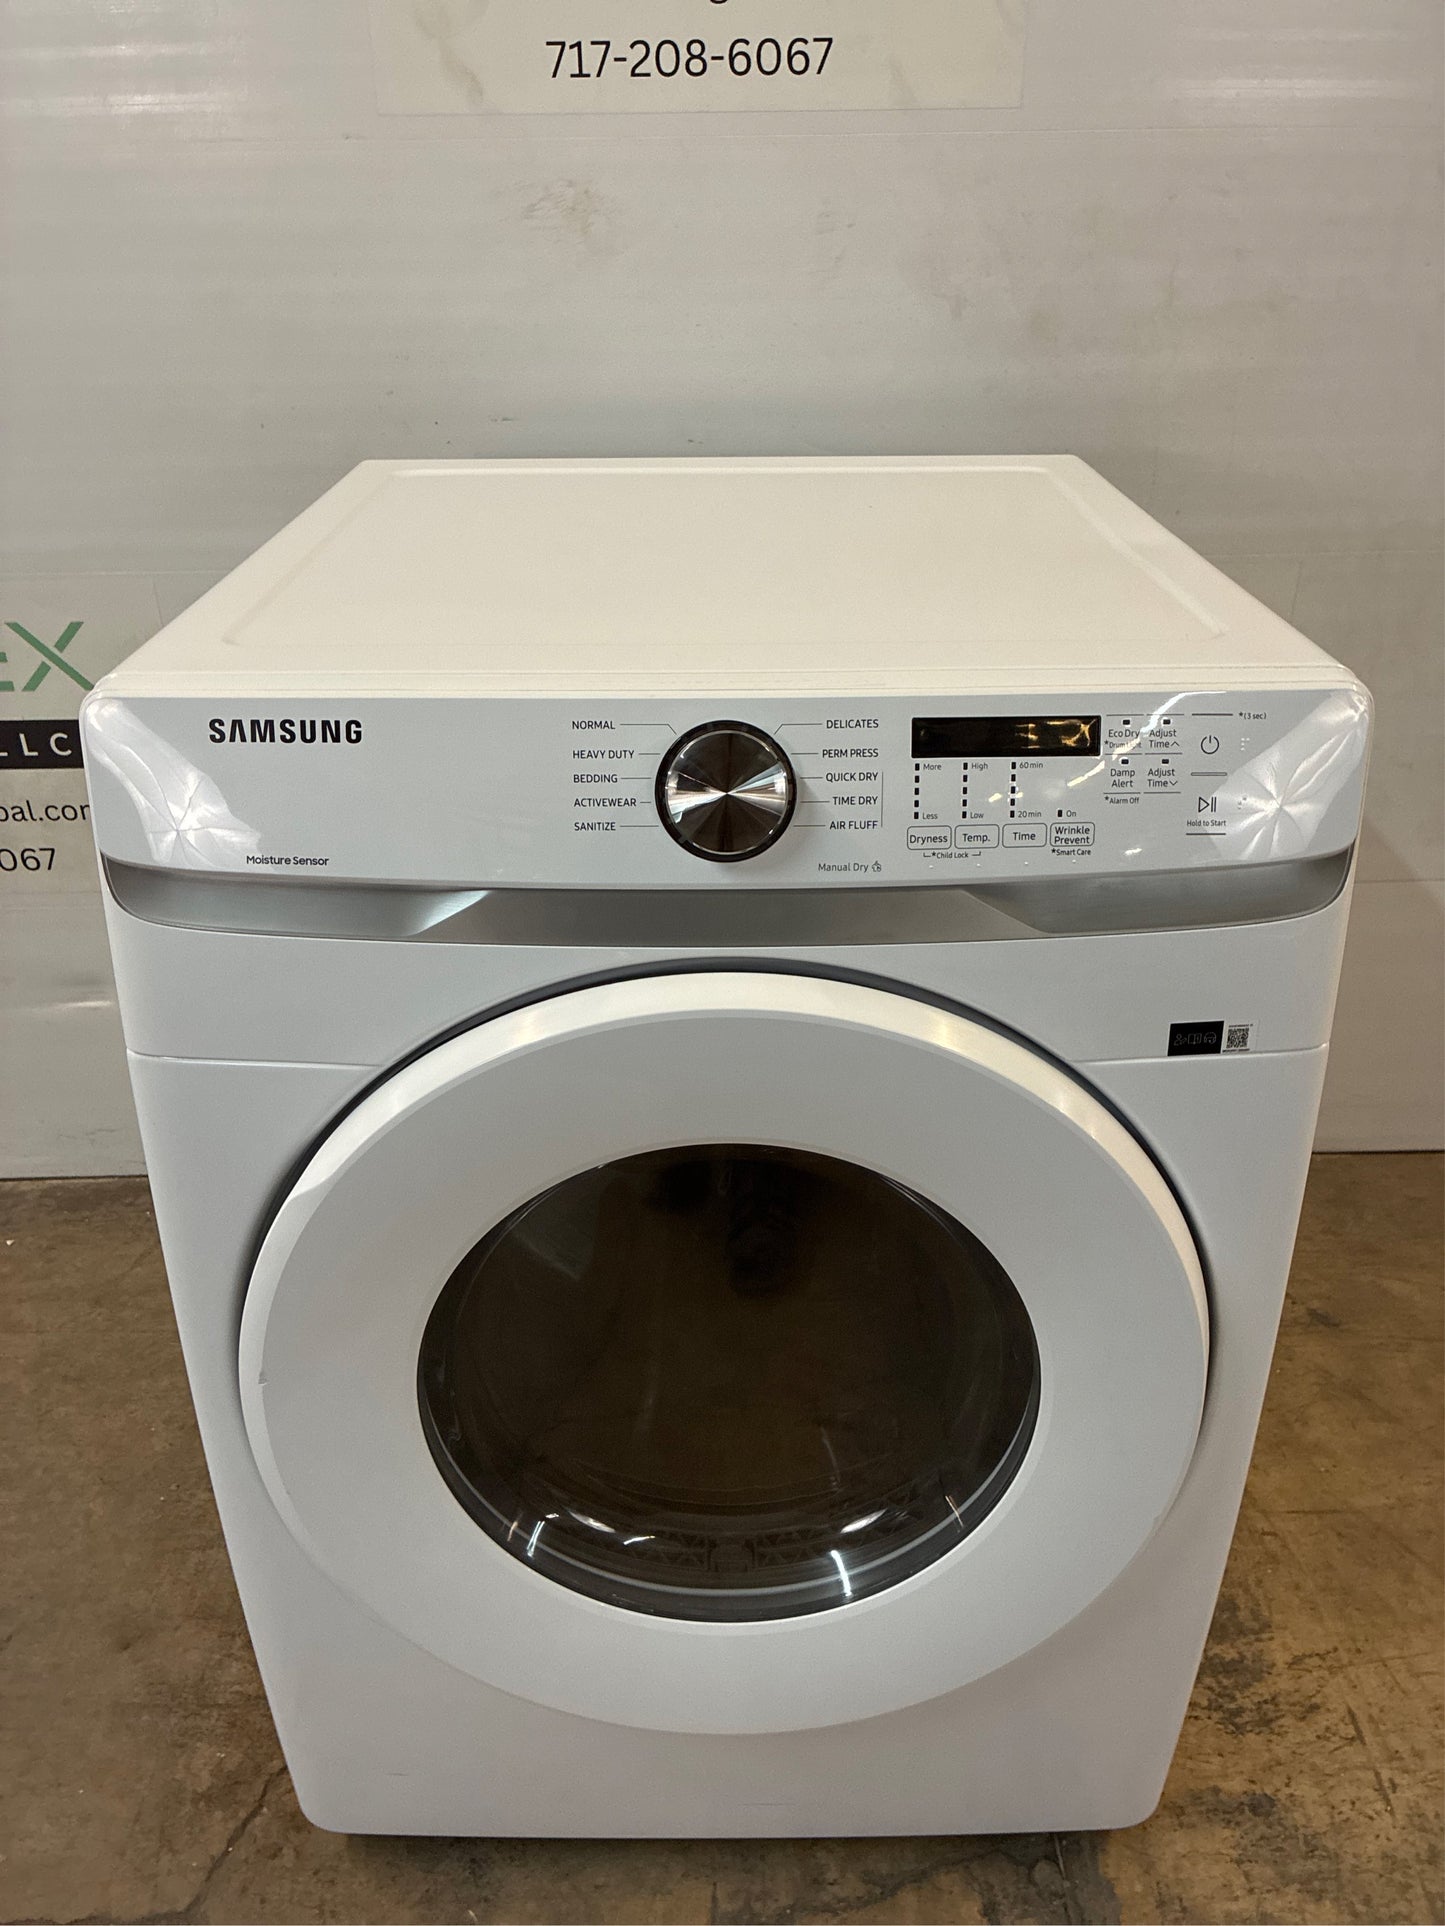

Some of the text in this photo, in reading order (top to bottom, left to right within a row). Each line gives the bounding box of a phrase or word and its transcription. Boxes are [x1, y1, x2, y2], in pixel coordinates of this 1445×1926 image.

[545, 37, 834, 79] 717-208-6067
[572, 720, 616, 730] NORMAL
[826, 719, 879, 729] DELICATES
[208, 718, 363, 744] SAMSUNG
[1108, 729, 1140, 738] Eco Dry
[1148, 728, 1176, 739] Adjust
[1149, 740, 1170, 748] Time
[572, 750, 635, 760] HEAVY DUTY
[822, 748, 879, 758] PERM PRESS
[971, 762, 988, 770] High
[825, 772, 878, 783] QUICK DRY
[1110, 768, 1136, 778] Damp
[1148, 768, 1175, 778] Adjust
[573, 774, 618, 784] BEDDING
[1112, 780, 1134, 788] Alert
[1148, 779, 1168, 788] Time
[573, 798, 637, 808] ACTIVEWEAR
[832, 796, 878, 806] TIME DRY
[574, 822, 616, 832] SANITIZE
[829, 820, 878, 830] AIR FLUFF
[1054, 826, 1090, 835] Wrinkle
[909, 834, 948, 845] Dryness
[962, 834, 990, 843] Temp.
[1013, 832, 1036, 840] Time
[1054, 836, 1090, 844] Prevent
[246, 854, 330, 866] Moisture Sensor
[818, 862, 869, 873] Manual Dry
